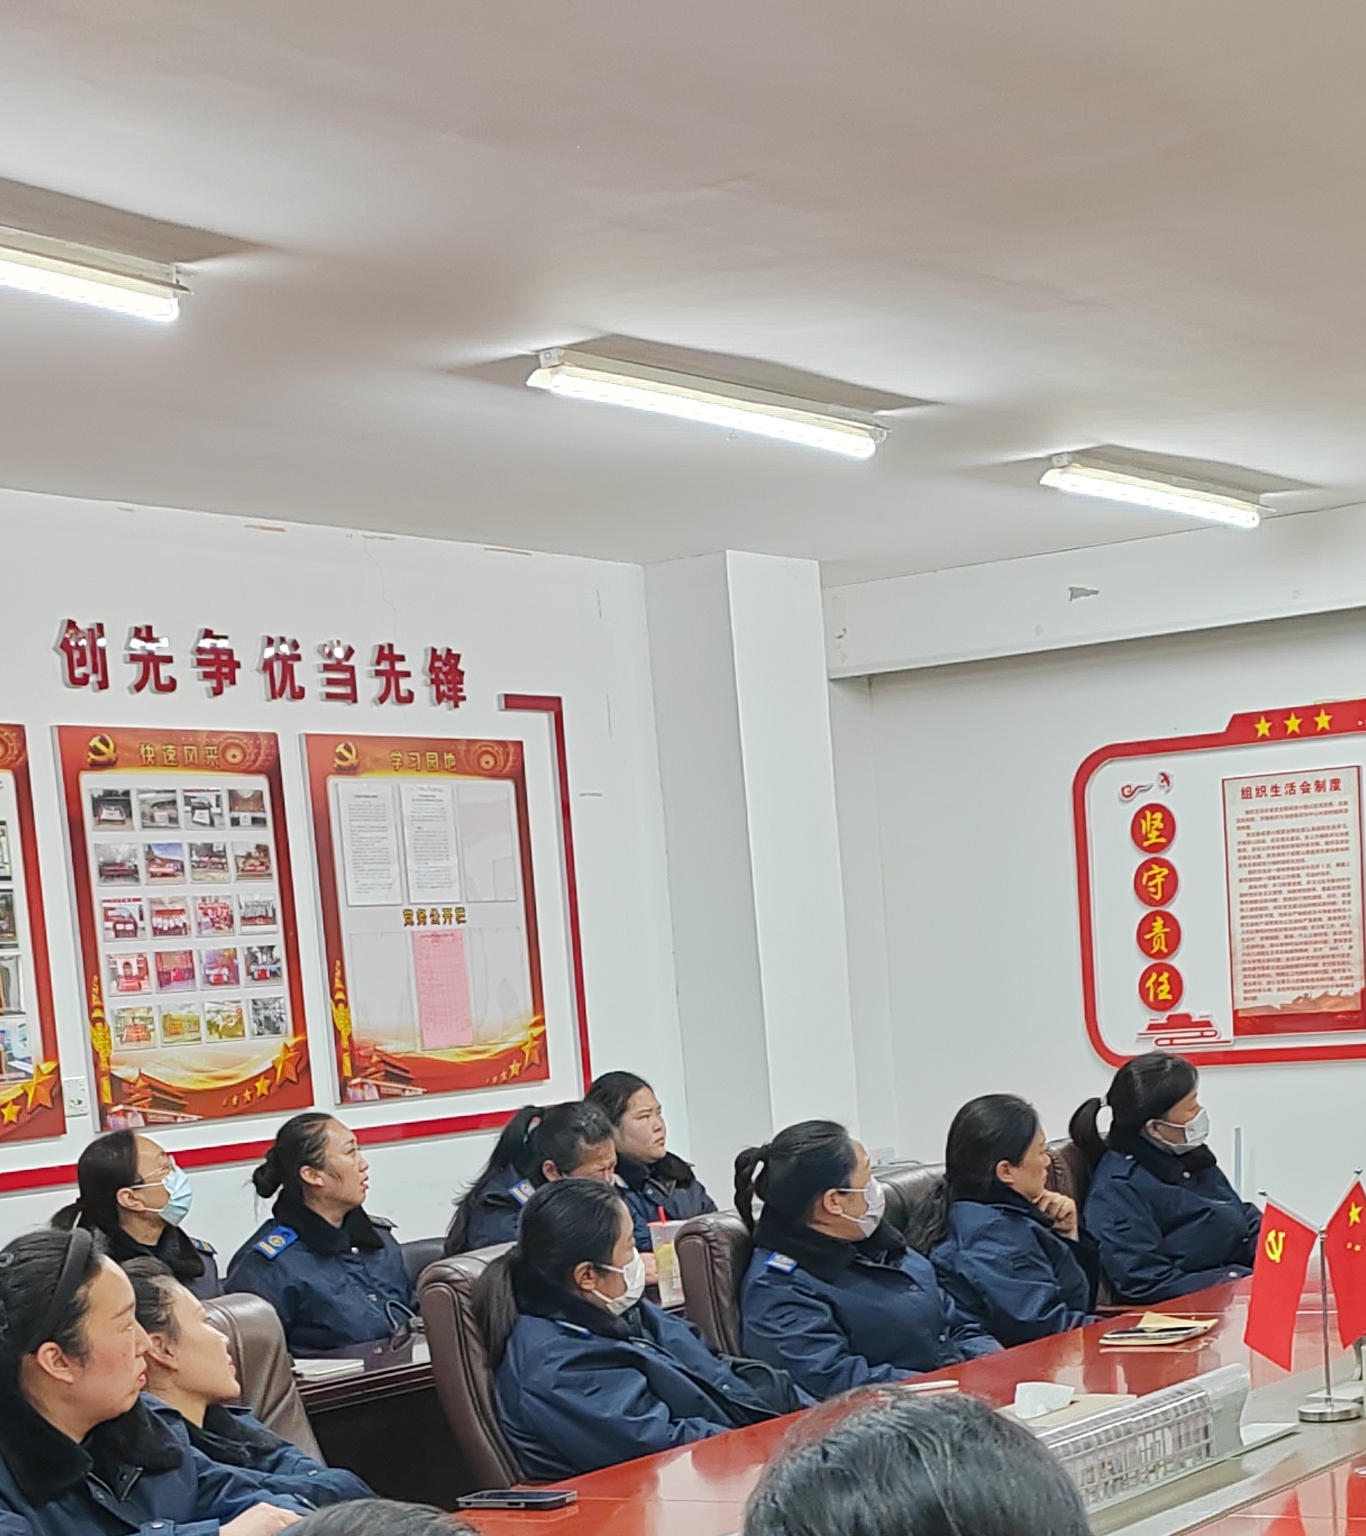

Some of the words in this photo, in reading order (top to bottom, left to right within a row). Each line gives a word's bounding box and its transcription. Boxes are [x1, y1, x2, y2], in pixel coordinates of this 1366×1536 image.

[51, 618, 468, 709] 创先争优当先锋
[138, 743, 222, 767] 快速风采
[389, 750, 457, 773] 学习园地
[1240, 777, 1343, 800] 组织生活会制度
[402, 906, 468, 928] 党务公开栏
[1140, 810, 1174, 1003] 坚守责任
